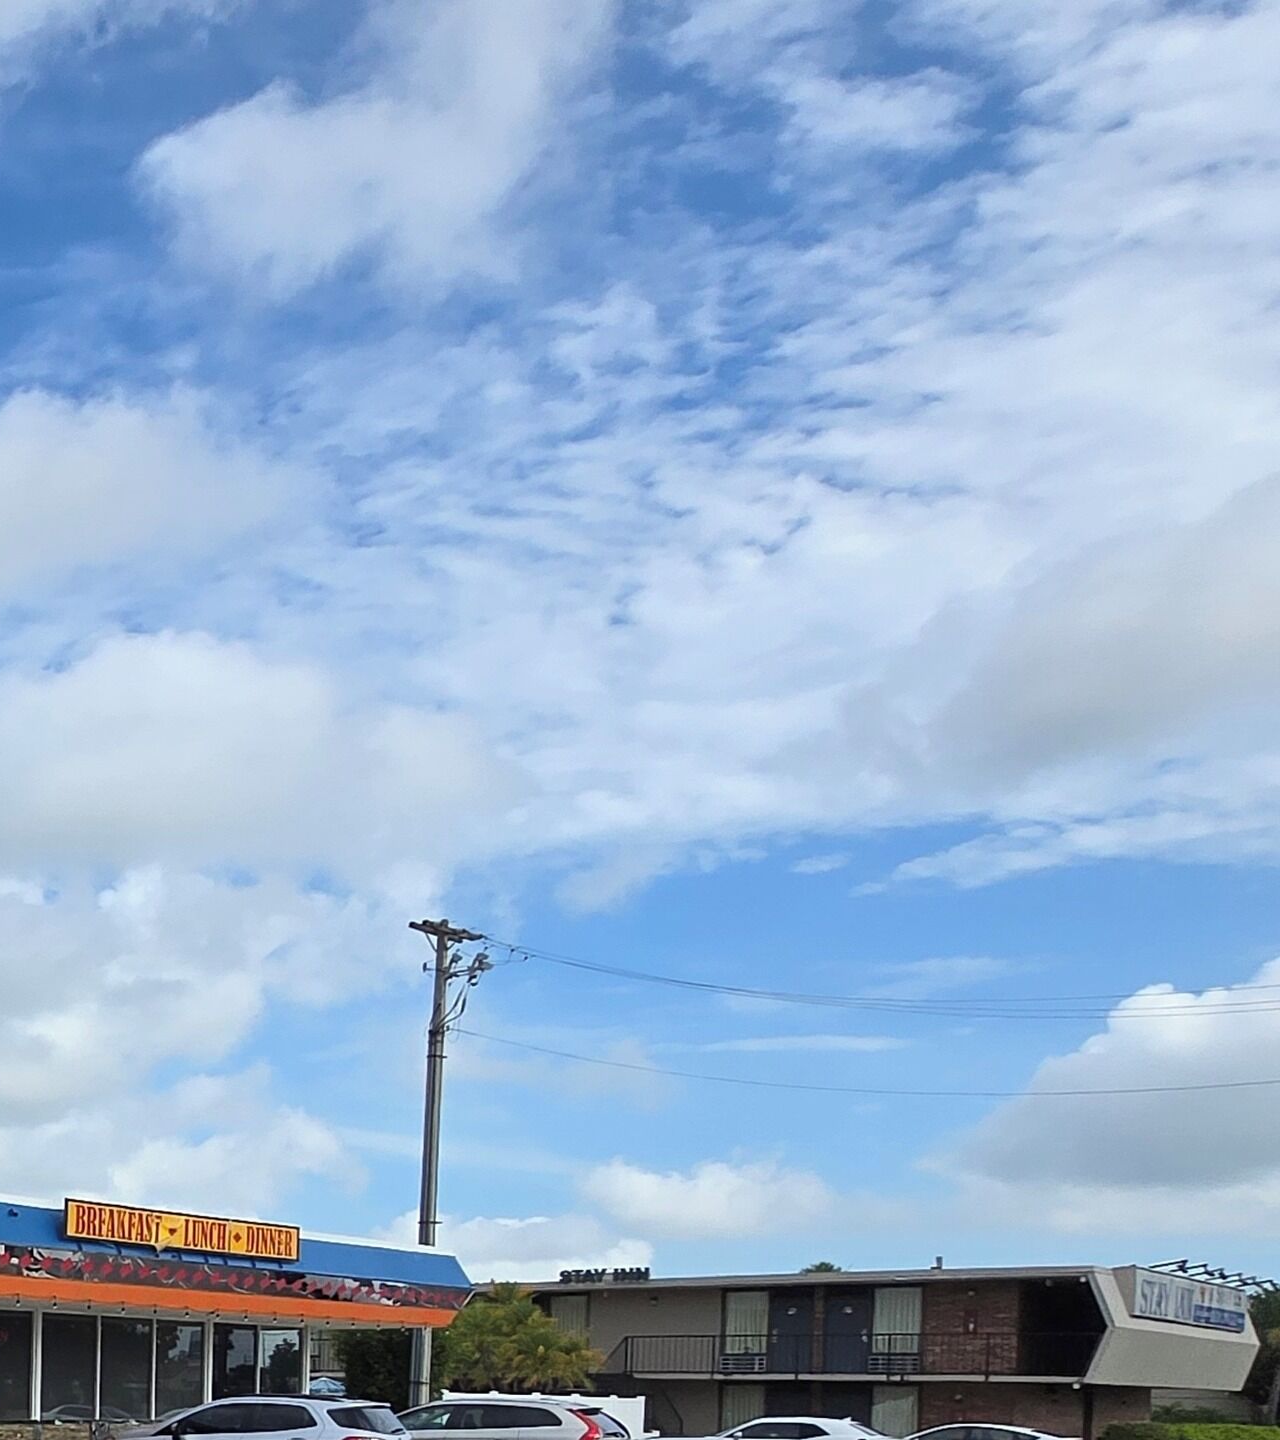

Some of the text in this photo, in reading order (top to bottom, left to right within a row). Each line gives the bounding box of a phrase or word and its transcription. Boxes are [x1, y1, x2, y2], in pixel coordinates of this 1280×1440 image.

[75, 1204, 293, 1258] BREAKFAST LUNCH DINNER
[559, 1267, 650, 1284] STAY INN
